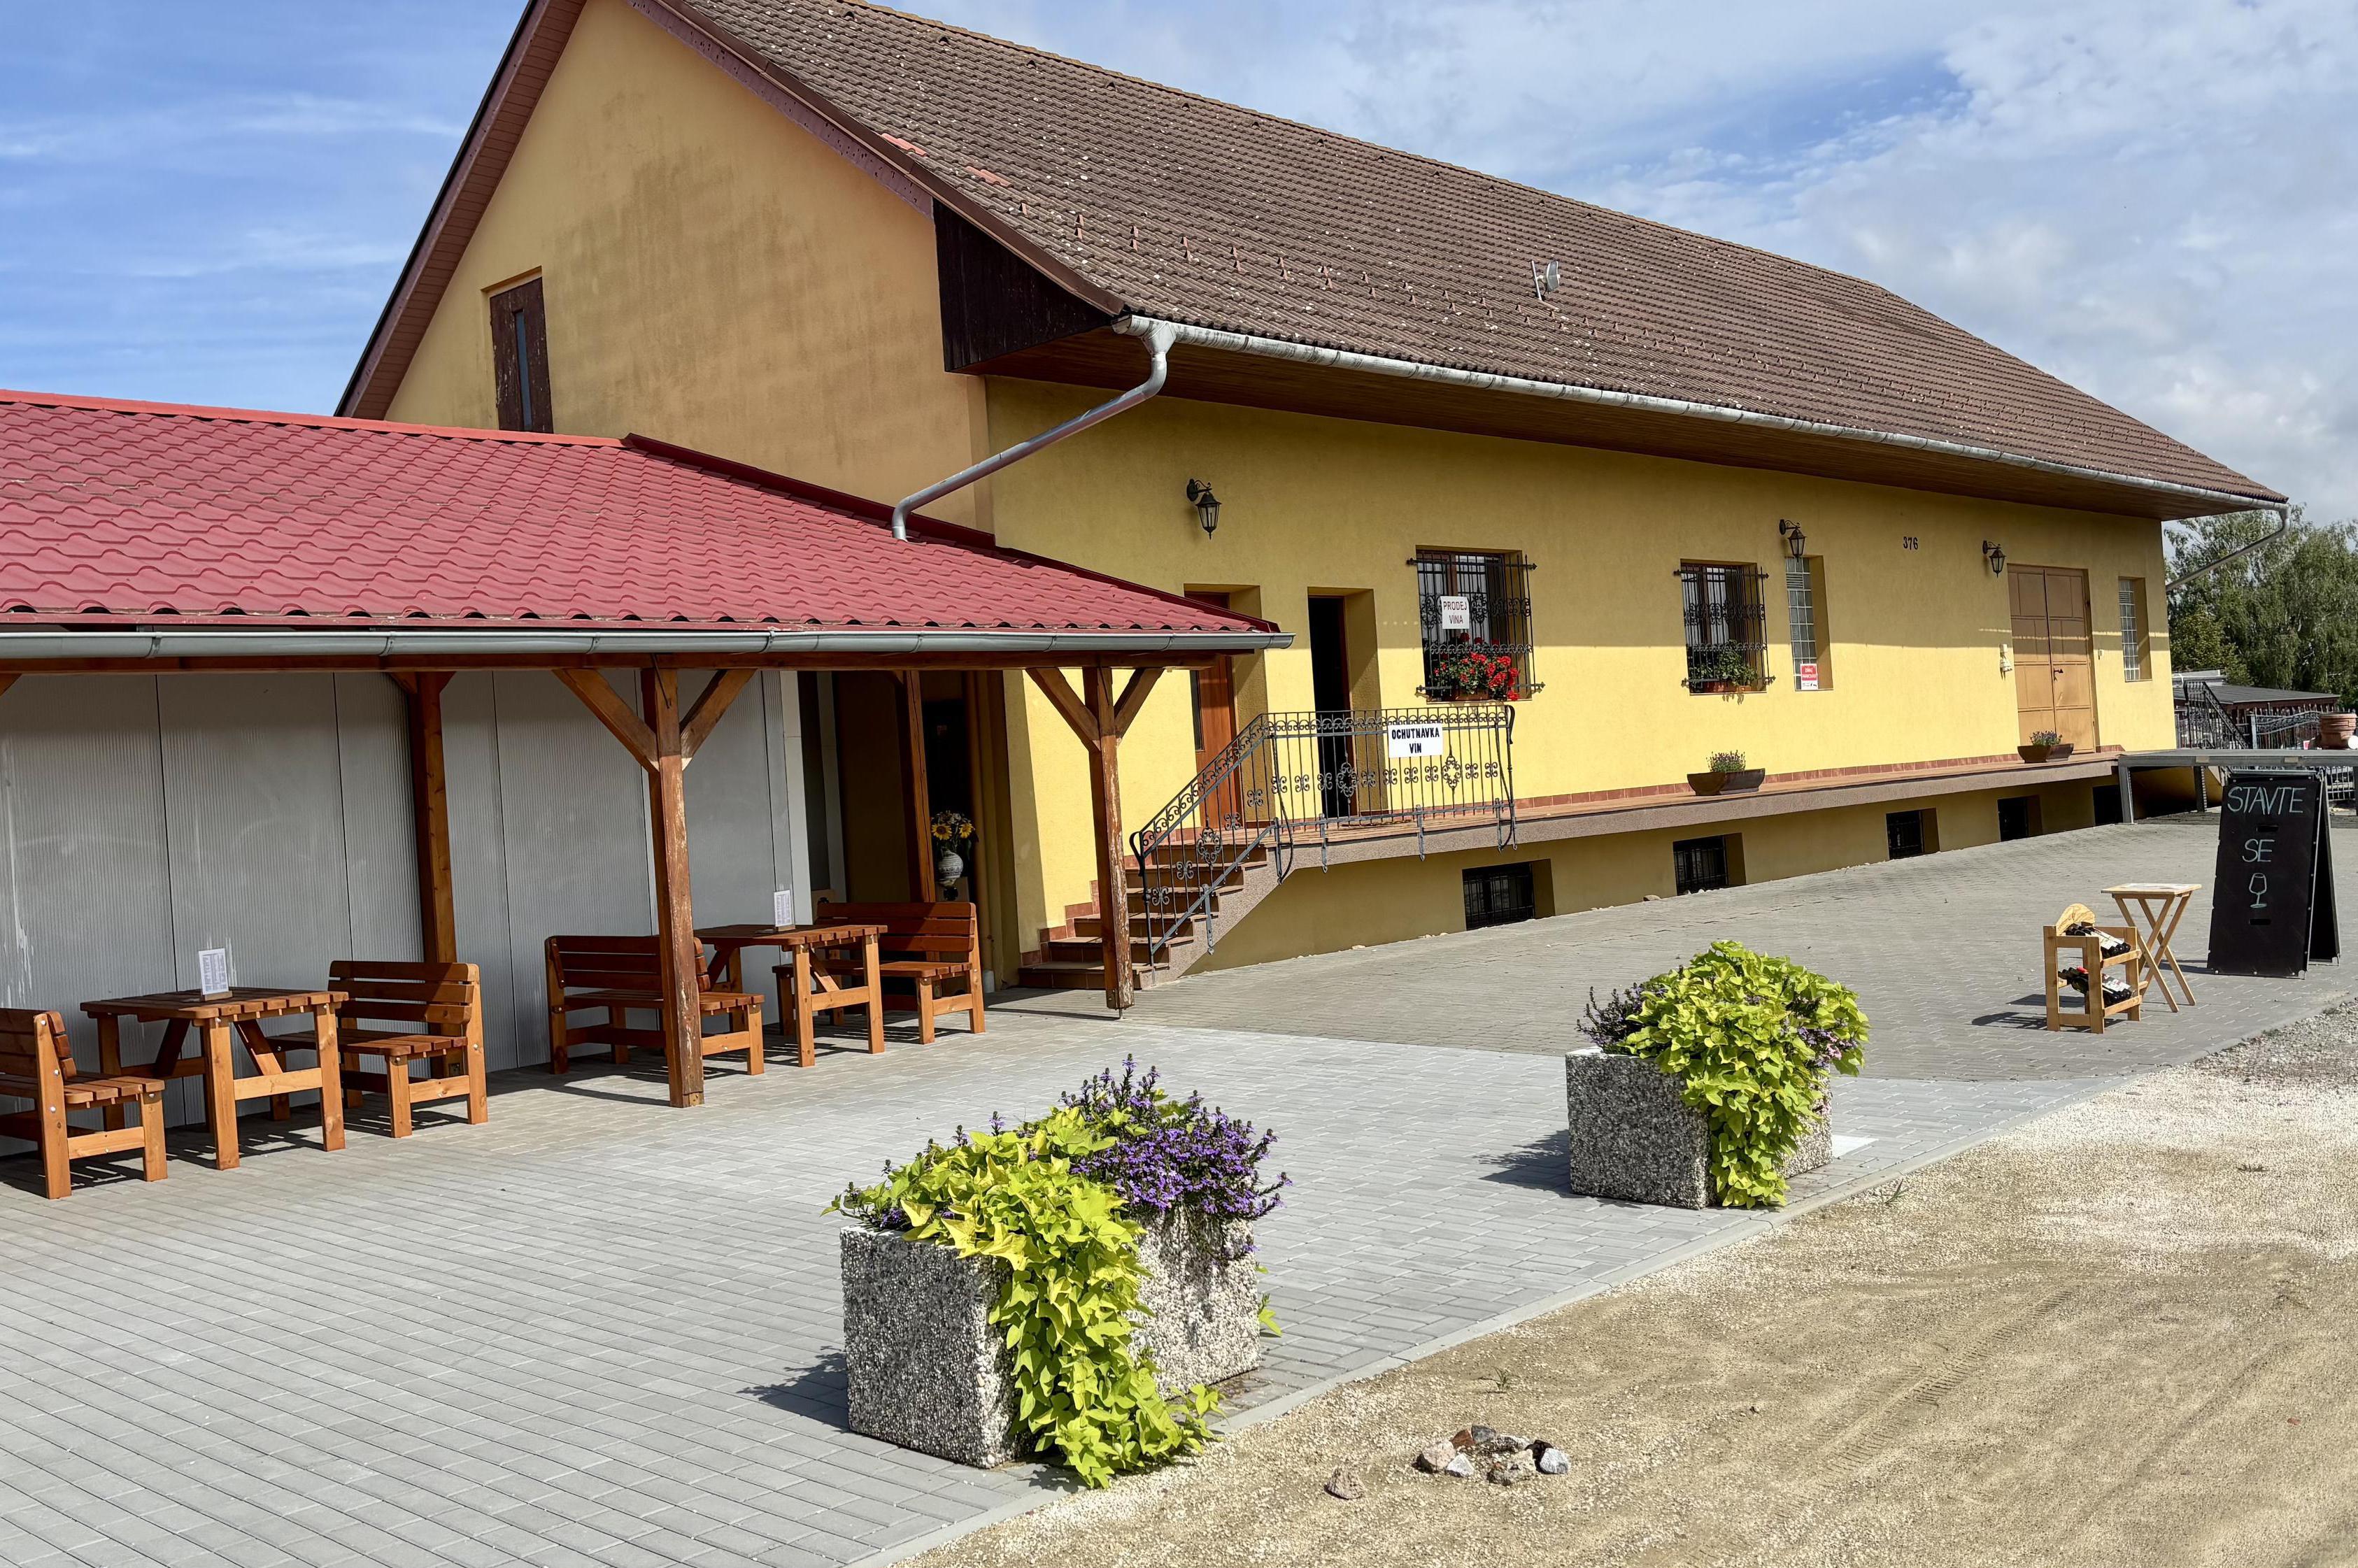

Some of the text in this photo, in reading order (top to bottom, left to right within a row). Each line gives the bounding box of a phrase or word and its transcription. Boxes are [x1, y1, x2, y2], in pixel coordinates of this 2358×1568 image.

[1903, 536, 1918, 550] 376
[1443, 601, 1468, 611] PRODEJ
[2227, 786, 2306, 815] STAVTE
[2242, 839, 2275, 862] SE
